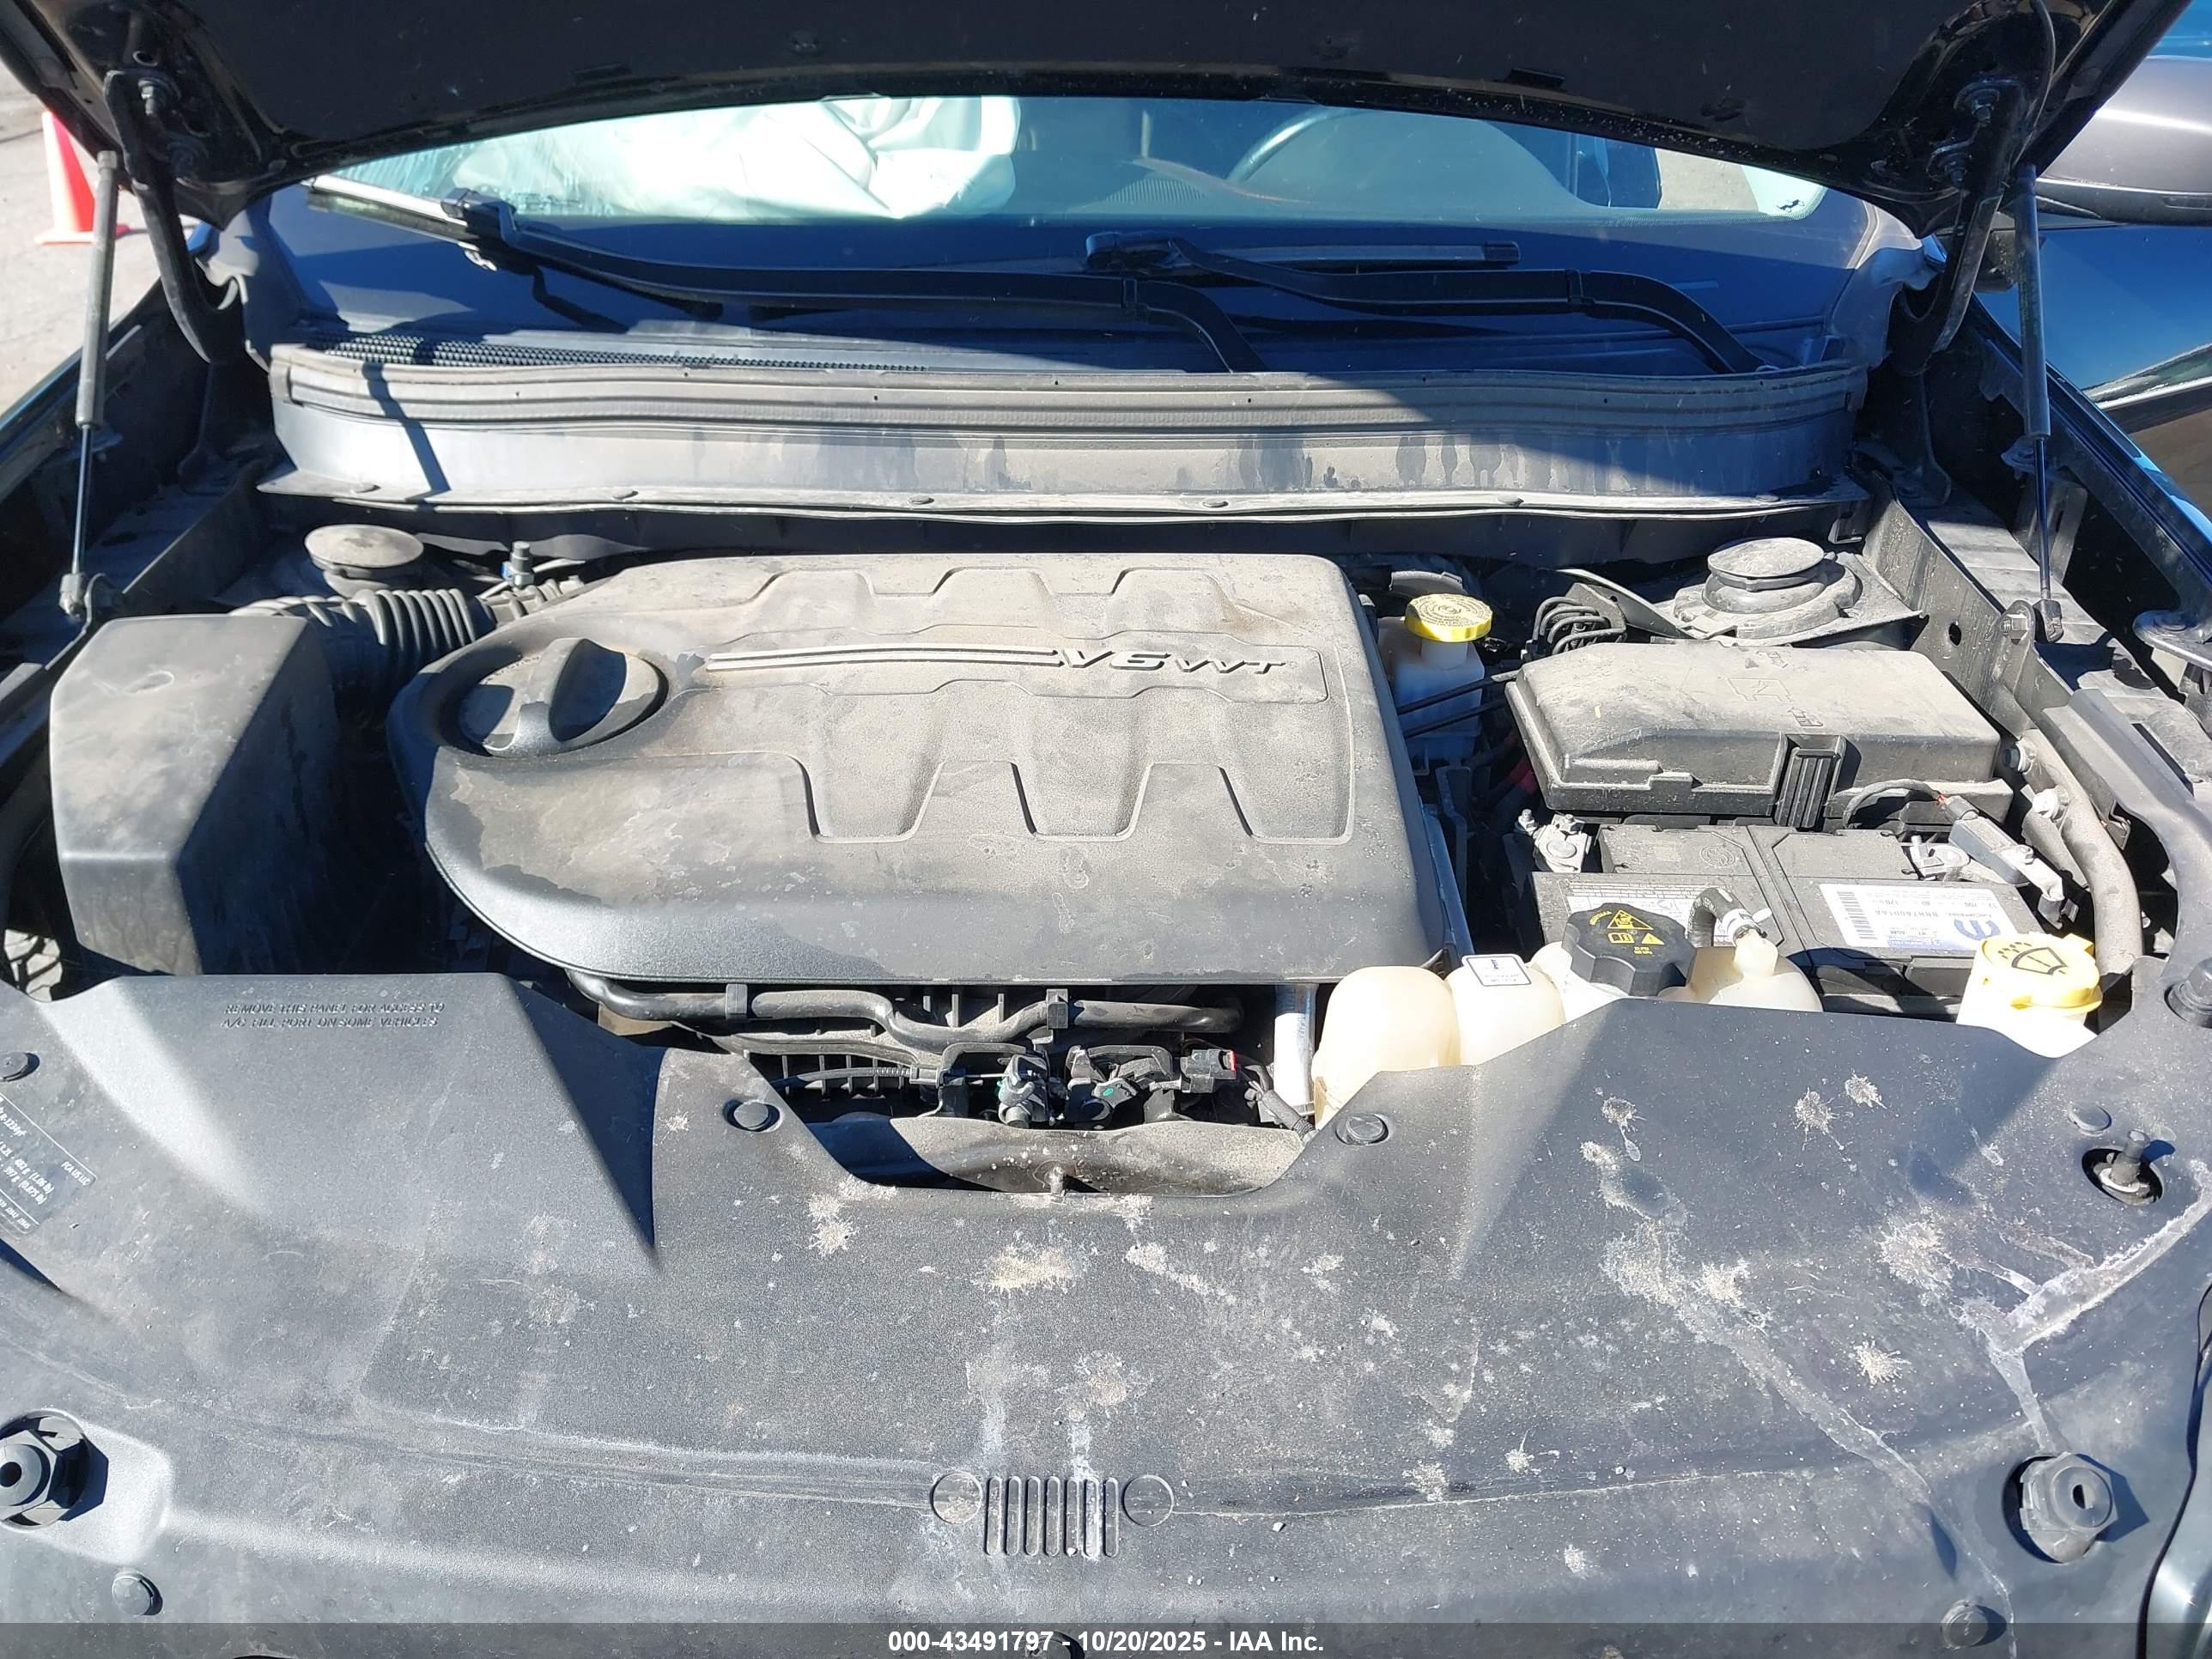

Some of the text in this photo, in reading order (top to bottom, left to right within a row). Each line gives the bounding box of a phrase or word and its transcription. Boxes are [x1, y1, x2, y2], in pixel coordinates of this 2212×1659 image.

[1063, 650, 1286, 674] V6 VVT
[224, 1003, 445, 1013] REMOVE THIS PANEL FOR ACCESS TO
[251, 1018, 276, 1028] FILL
[281, 1018, 313, 1027] PORT
[317, 1018, 337, 1027] ON
[338, 1018, 375, 1027] SOME
[380, 1017, 439, 1027] VEHICLES
[61, 1161, 75, 1173] FCA
